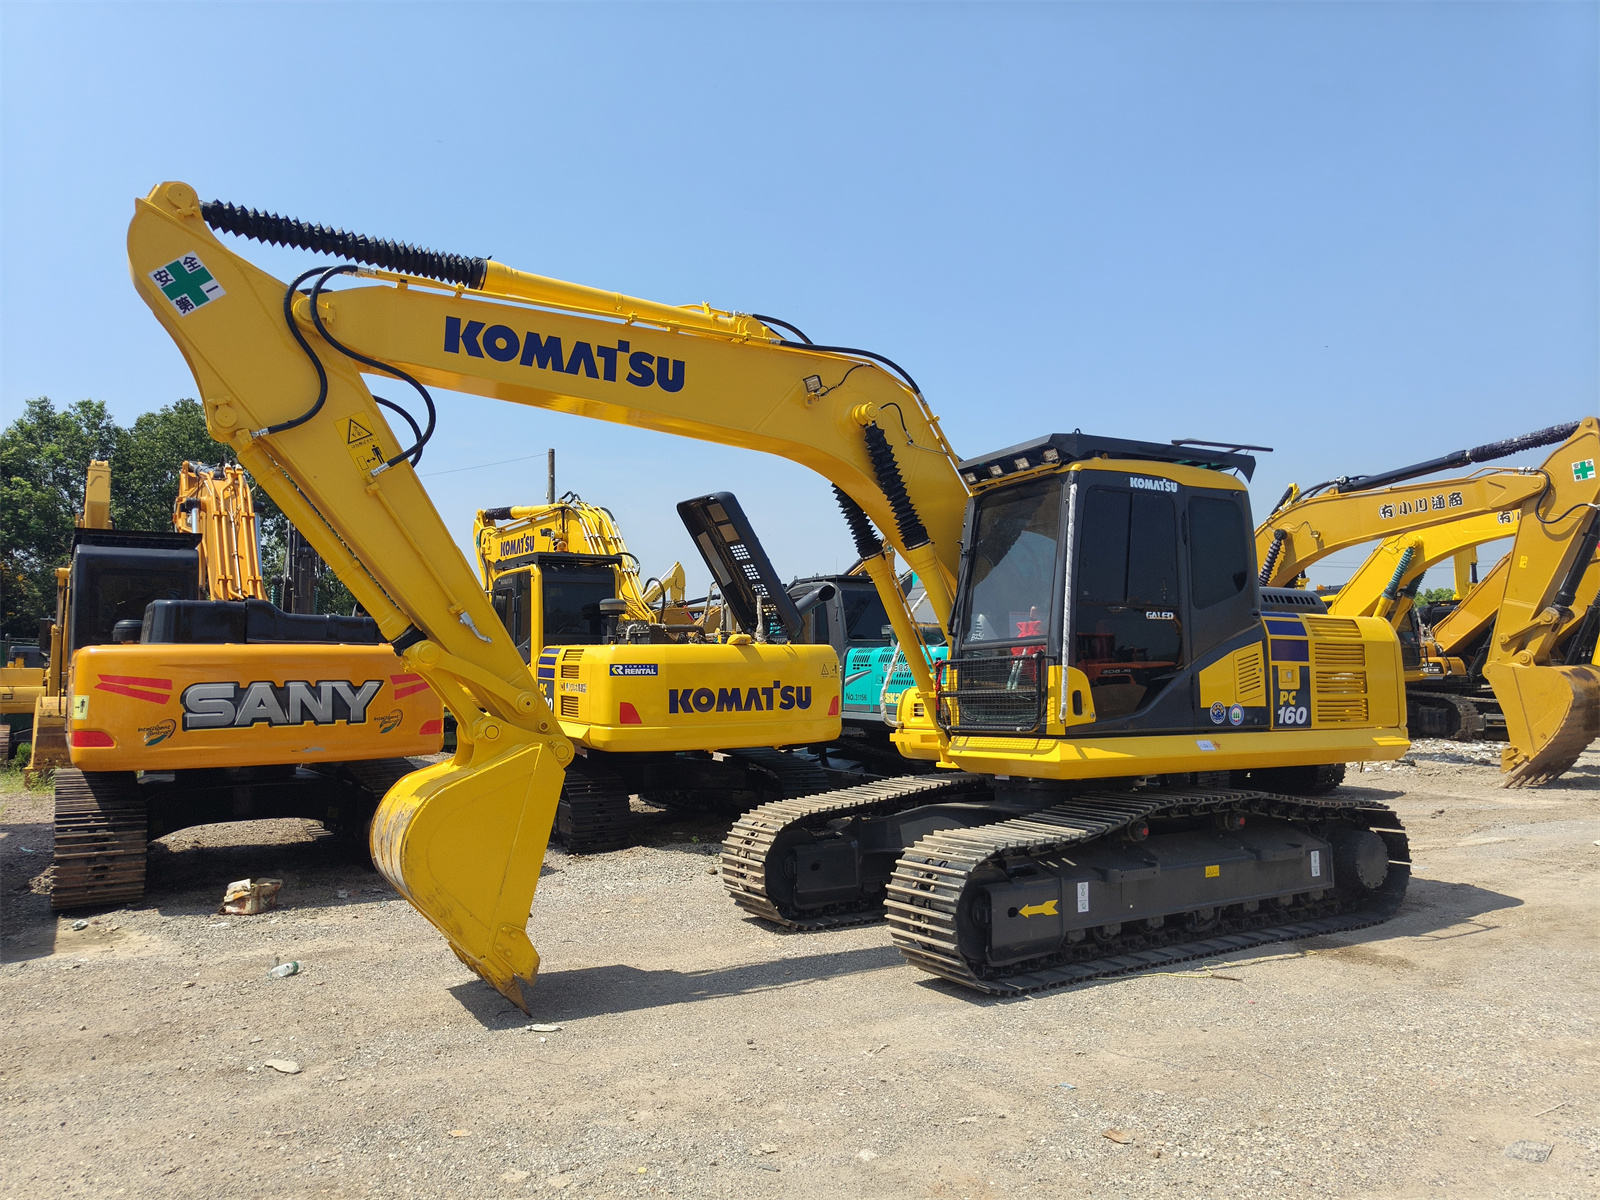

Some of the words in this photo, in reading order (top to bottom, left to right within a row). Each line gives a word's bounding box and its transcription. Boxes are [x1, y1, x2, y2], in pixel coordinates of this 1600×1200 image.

[153, 256, 201, 287] 安全
[175, 285, 219, 314] 第一
[444, 316, 685, 393] KOMATSU
[1129, 477, 1178, 492] KOMATSU
[500, 533, 534, 556] KOMATSU
[182, 680, 384, 731] SANY
[669, 680, 812, 714] KOMATSU
[1279, 691, 1297, 706] PC
[1278, 706, 1308, 725] 160
